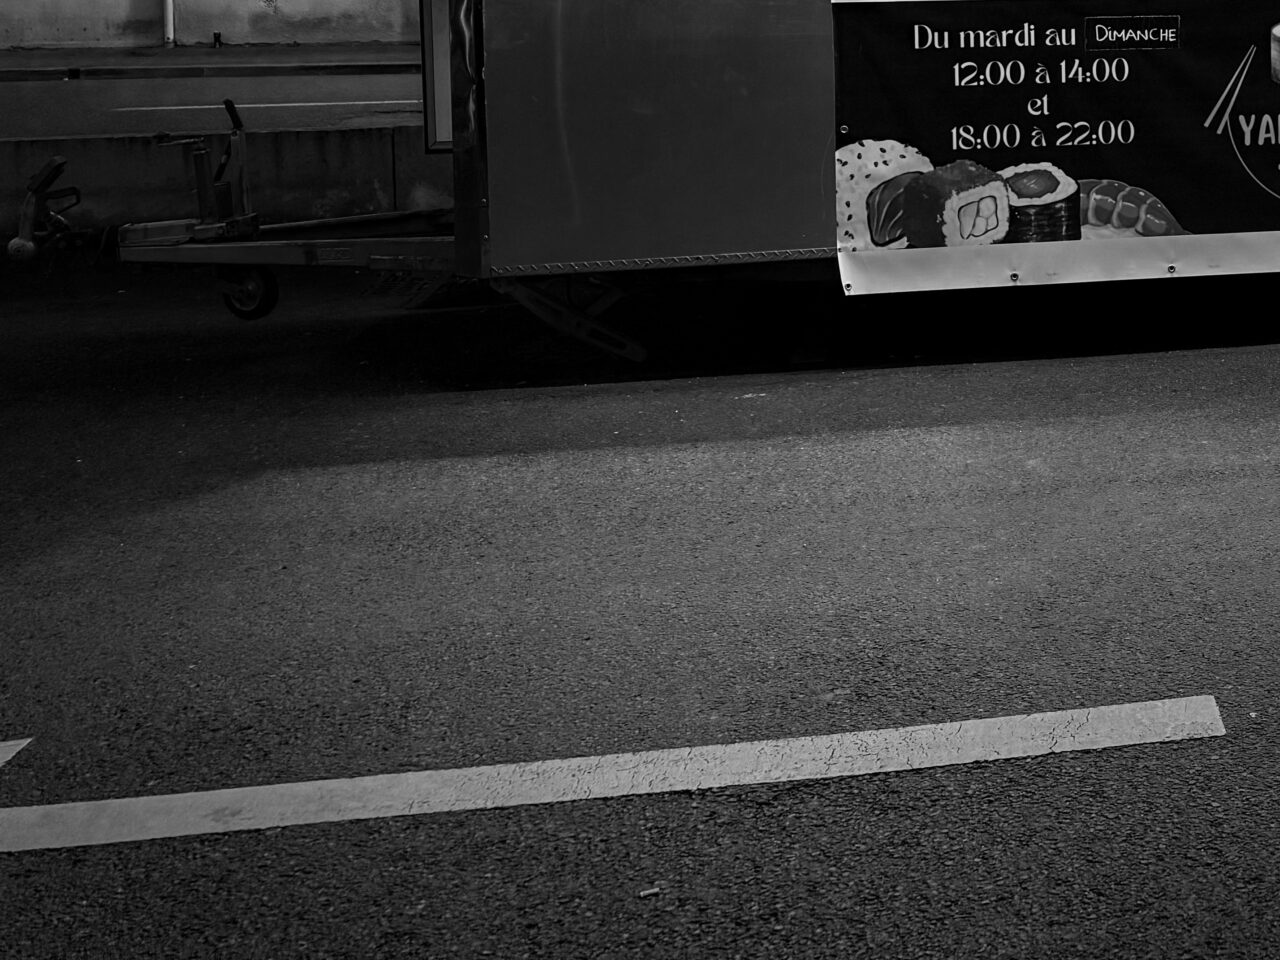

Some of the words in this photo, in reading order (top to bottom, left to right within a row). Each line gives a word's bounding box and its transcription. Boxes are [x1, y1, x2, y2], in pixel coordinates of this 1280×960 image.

[914, 24, 949, 49] Du
[959, 22, 1035, 48] mardi
[1045, 28, 1076, 46] au
[953, 60, 1025, 87] 12:00
[1035, 63, 1051, 84] à
[1060, 58, 1129, 83] 14:00
[1027, 94, 1049, 116] et
[951, 124, 1021, 150] 18:00
[1031, 126, 1047, 147] à
[1056, 120, 1135, 146] 22:00
